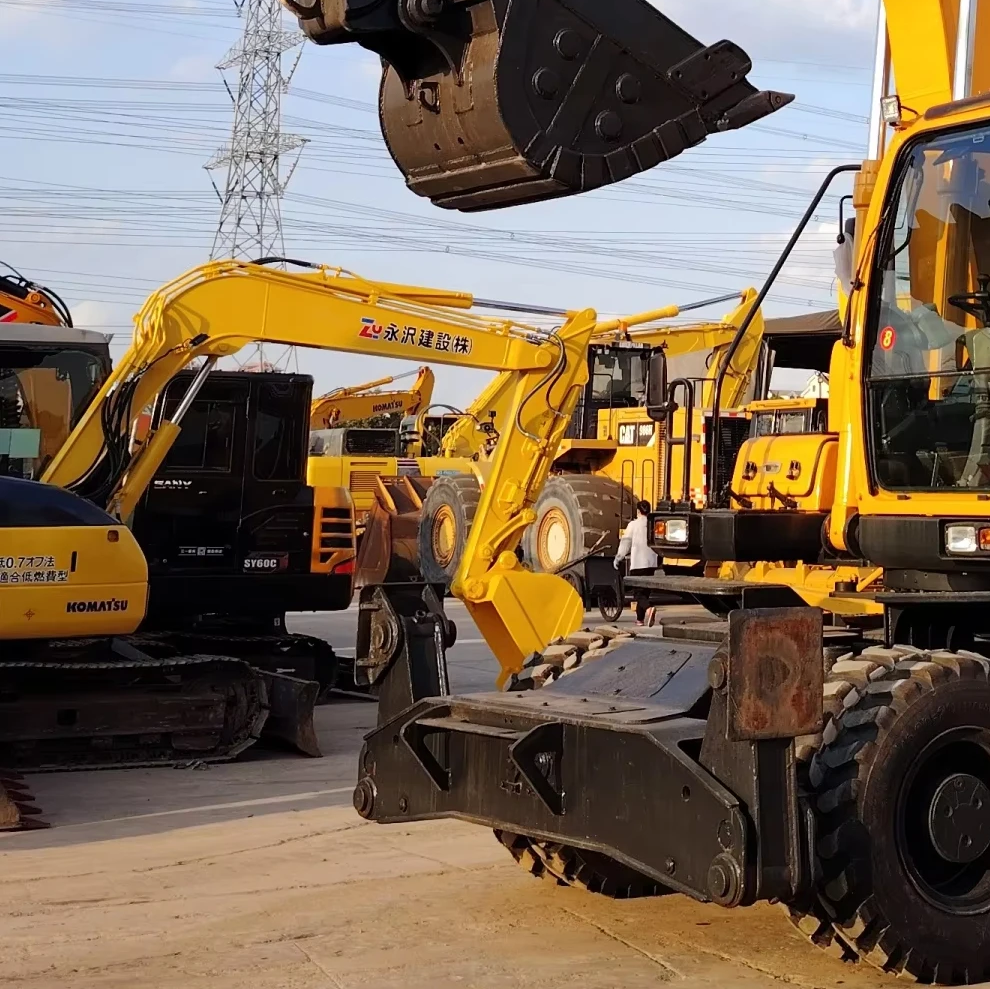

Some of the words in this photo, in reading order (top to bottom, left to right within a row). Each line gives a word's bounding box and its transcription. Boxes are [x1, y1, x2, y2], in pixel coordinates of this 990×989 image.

[372, 399, 403, 412] KOMATSU
[619, 424, 636, 445] CAT
[244, 559, 277, 568] SY60C
[66, 598, 129, 613] KOMATSU
